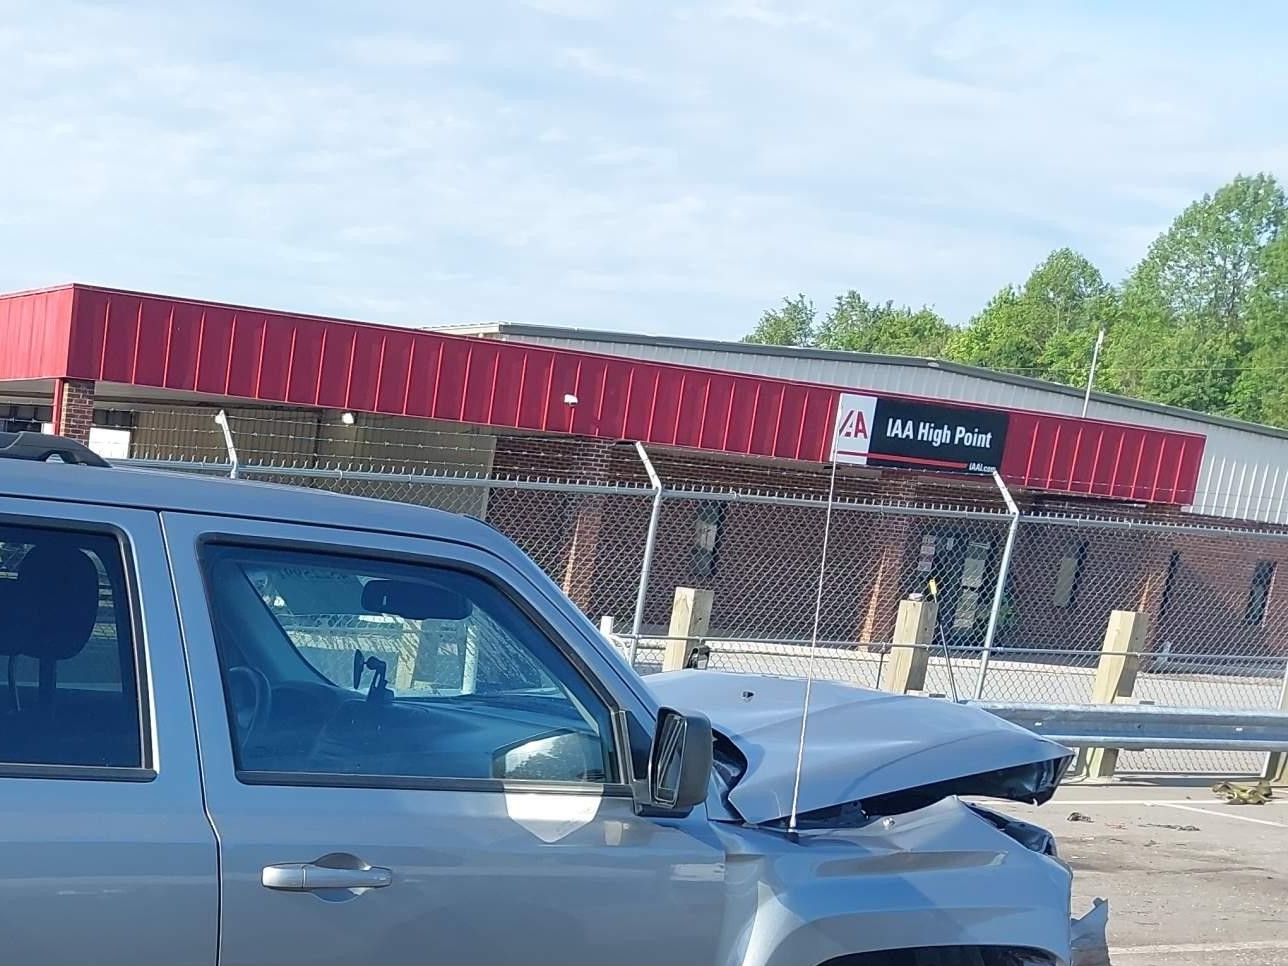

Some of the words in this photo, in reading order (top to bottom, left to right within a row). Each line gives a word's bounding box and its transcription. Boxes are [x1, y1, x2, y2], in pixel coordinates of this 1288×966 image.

[886, 418, 913, 440] IAA
[917, 421, 951, 447] High
[954, 425, 993, 449] Point
